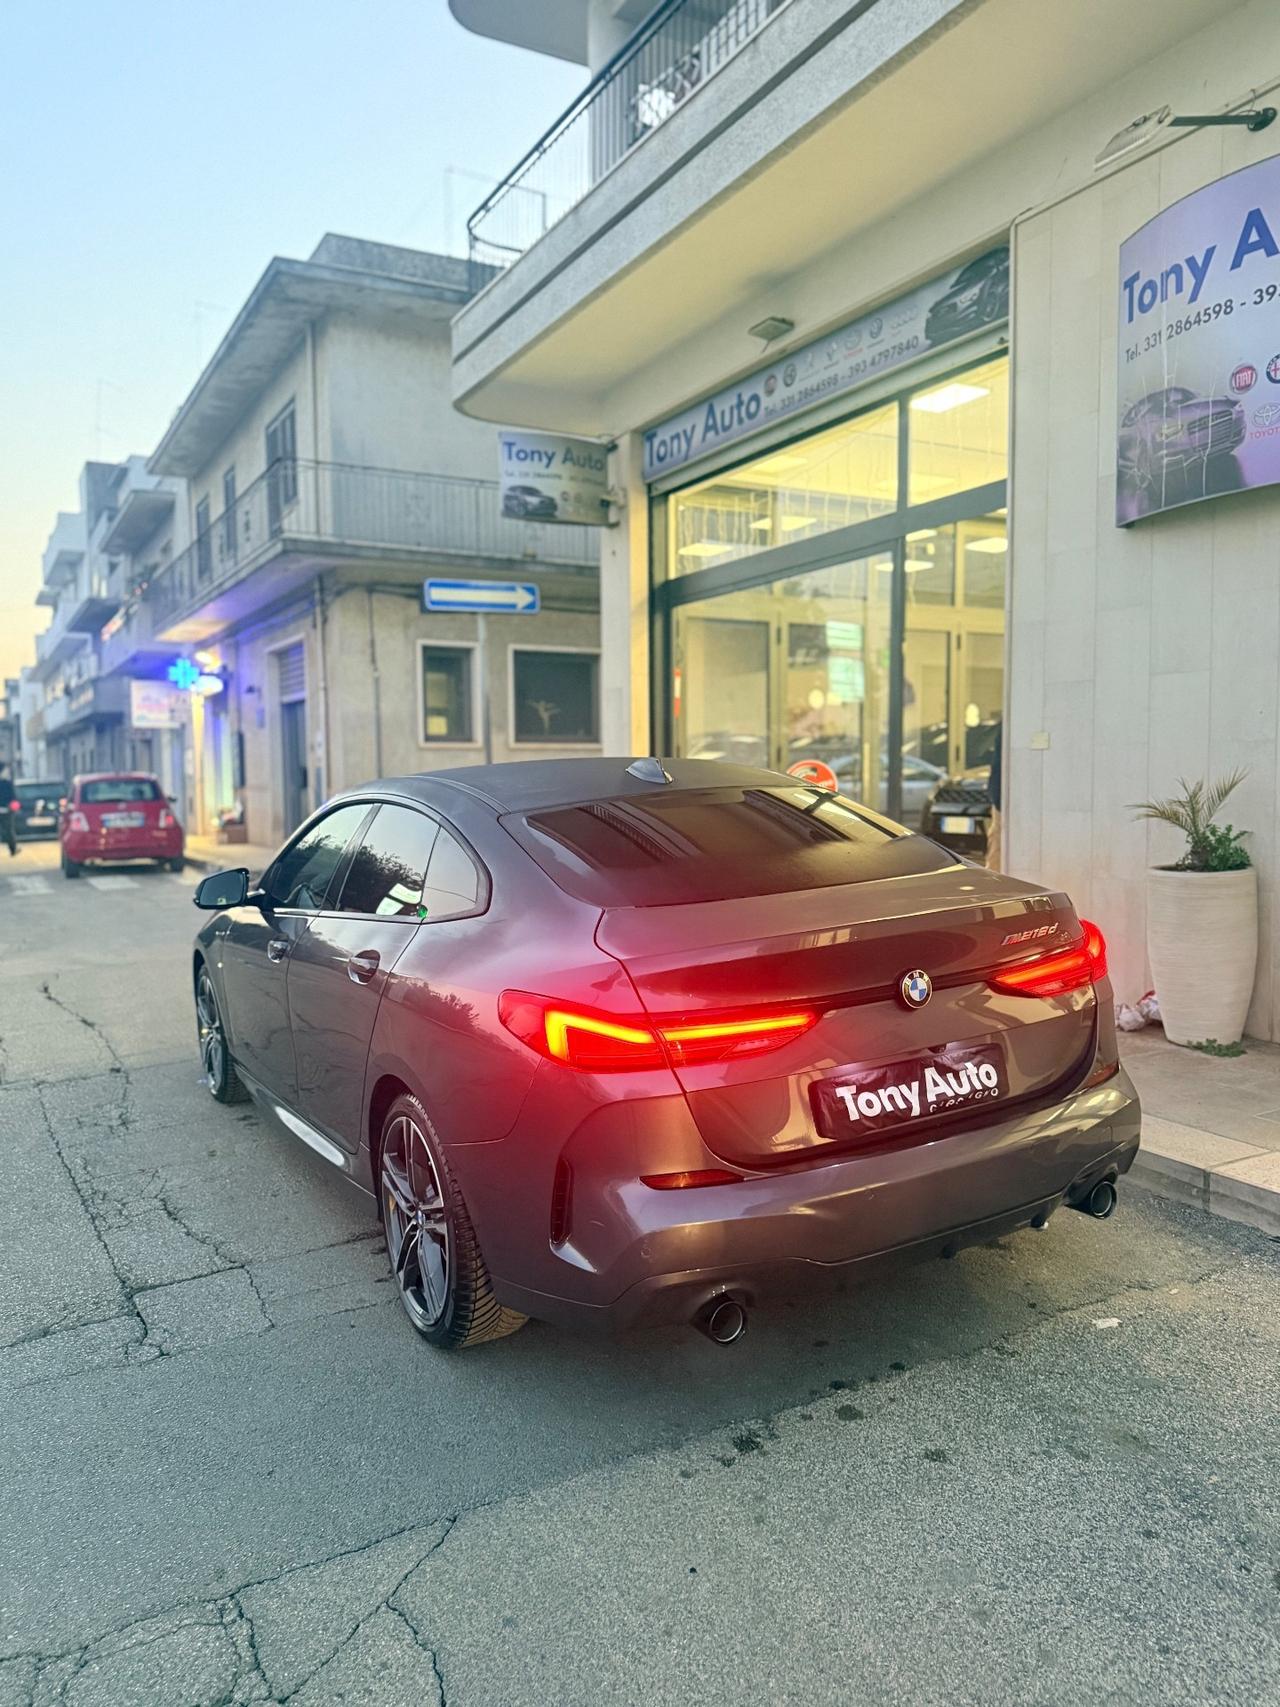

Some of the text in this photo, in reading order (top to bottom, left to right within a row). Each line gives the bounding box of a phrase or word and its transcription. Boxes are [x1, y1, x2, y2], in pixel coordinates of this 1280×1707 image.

[1123, 207, 1280, 324] Tony A
[1125, 344, 1141, 363] Tel.
[1144, 330, 1162, 352] 331
[1166, 299, 1234, 341] 2864598
[1253, 284, 1280, 306] 39
[503, 442, 605, 471] Tony Auto
[645, 392, 760, 467] Tony Auto
[1250, 425, 1280, 440] TOYOT
[836, 1081, 920, 1121] Tony
[924, 1062, 998, 1102] Auto
